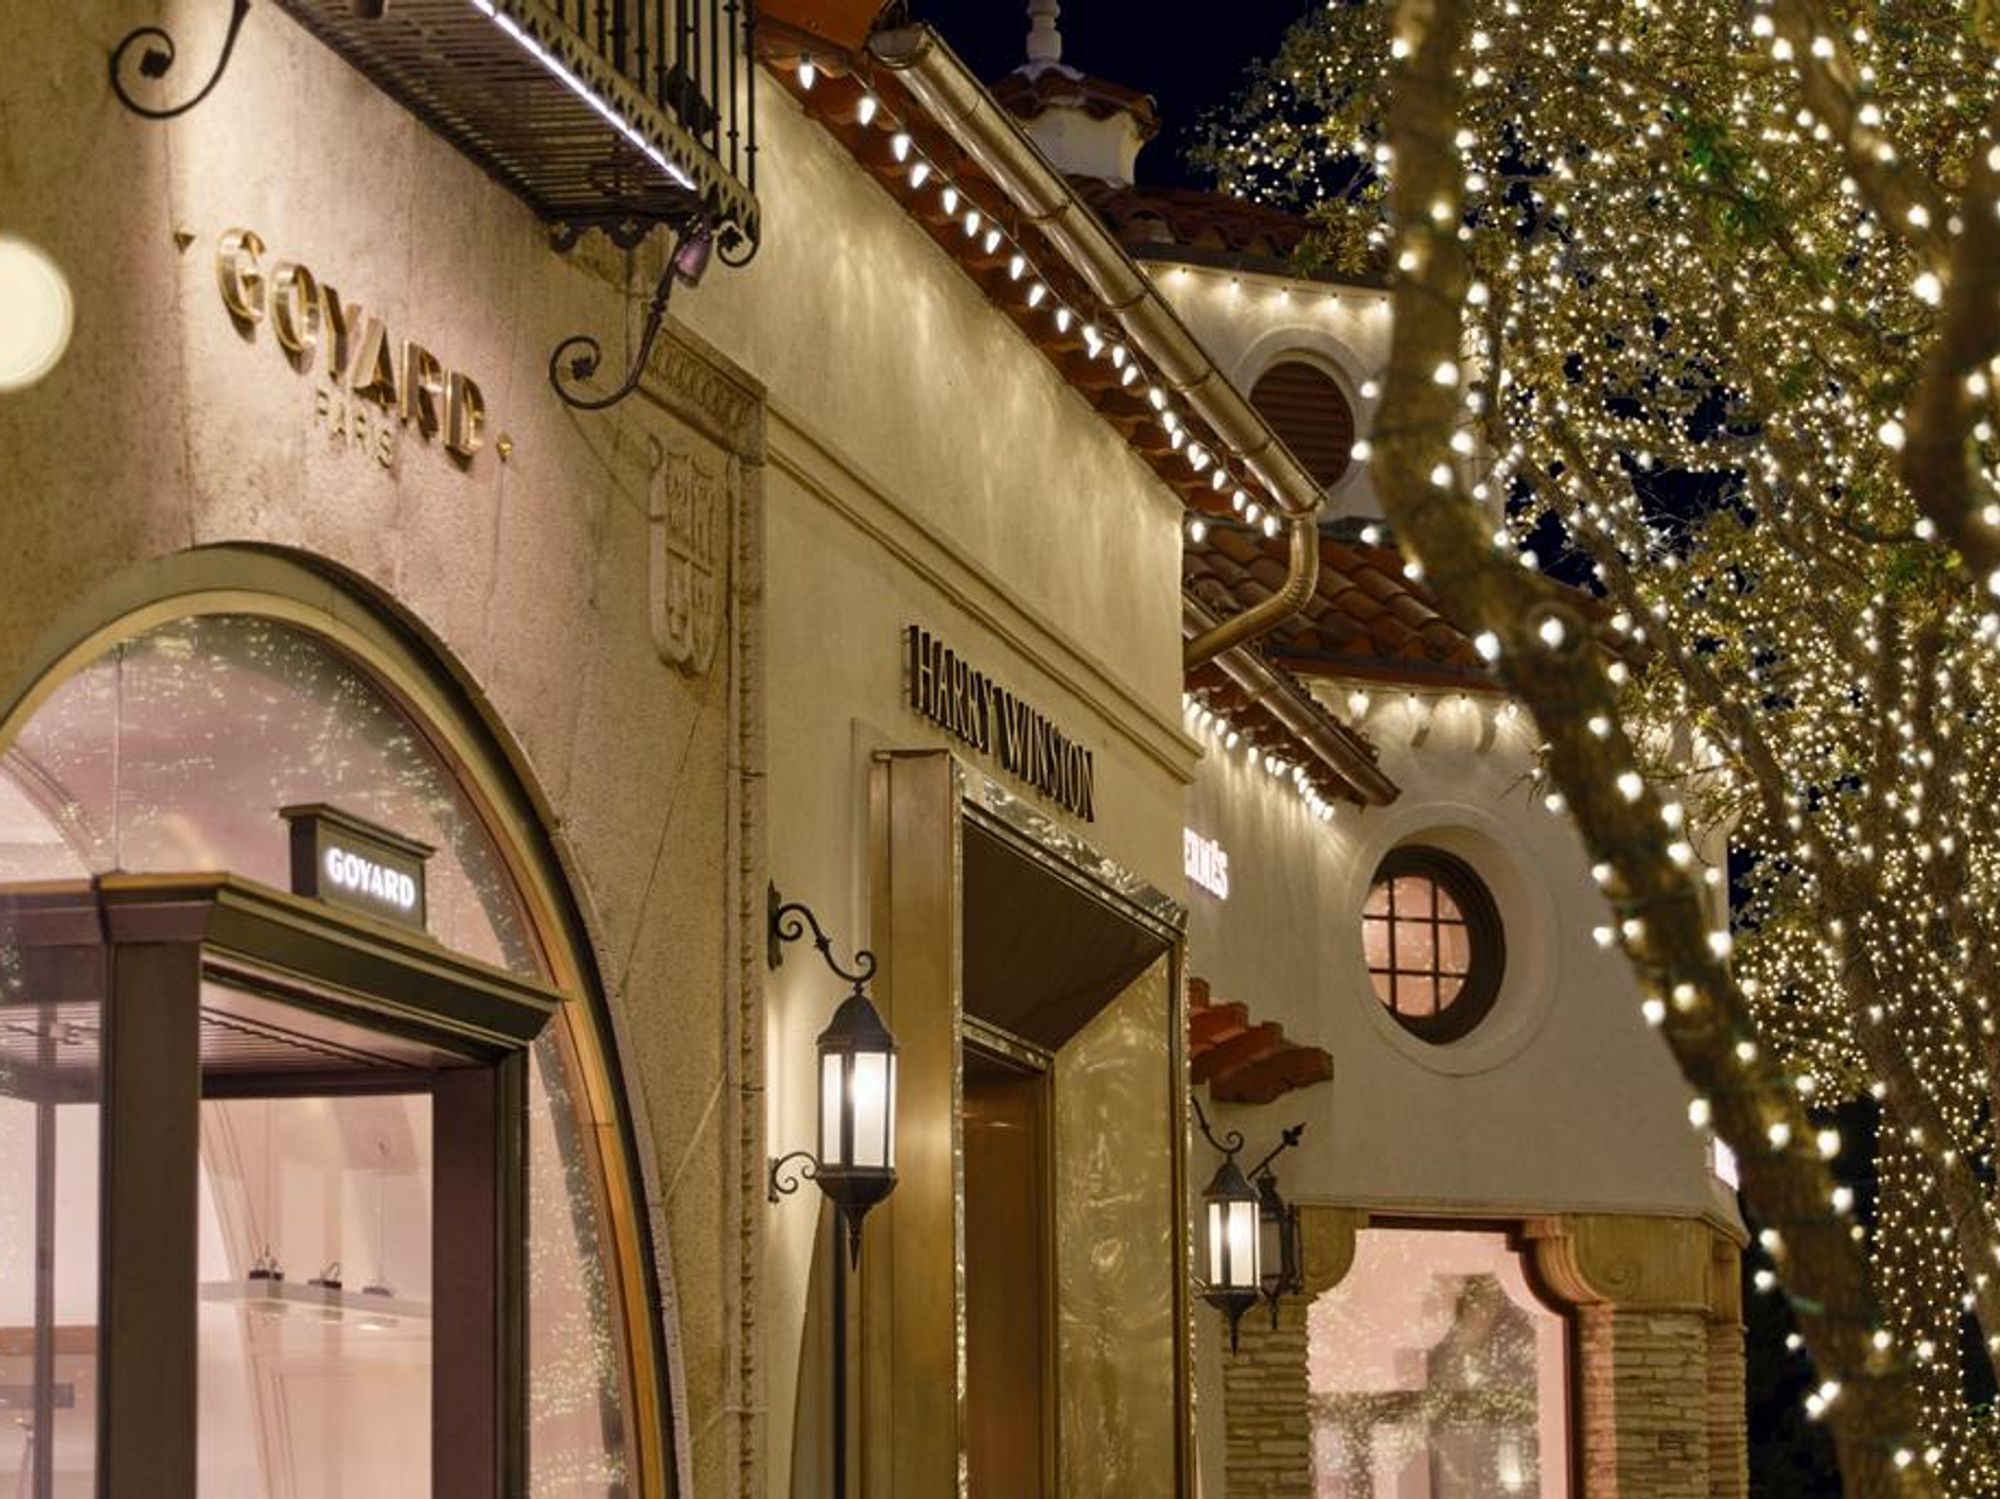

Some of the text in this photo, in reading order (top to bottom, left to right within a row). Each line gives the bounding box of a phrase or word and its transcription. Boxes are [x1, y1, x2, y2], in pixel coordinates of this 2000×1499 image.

[214, 227, 486, 458] GOYARD
[909, 624, 1095, 823] HARRY WINSTON
[325, 847, 416, 907] GOYARD
